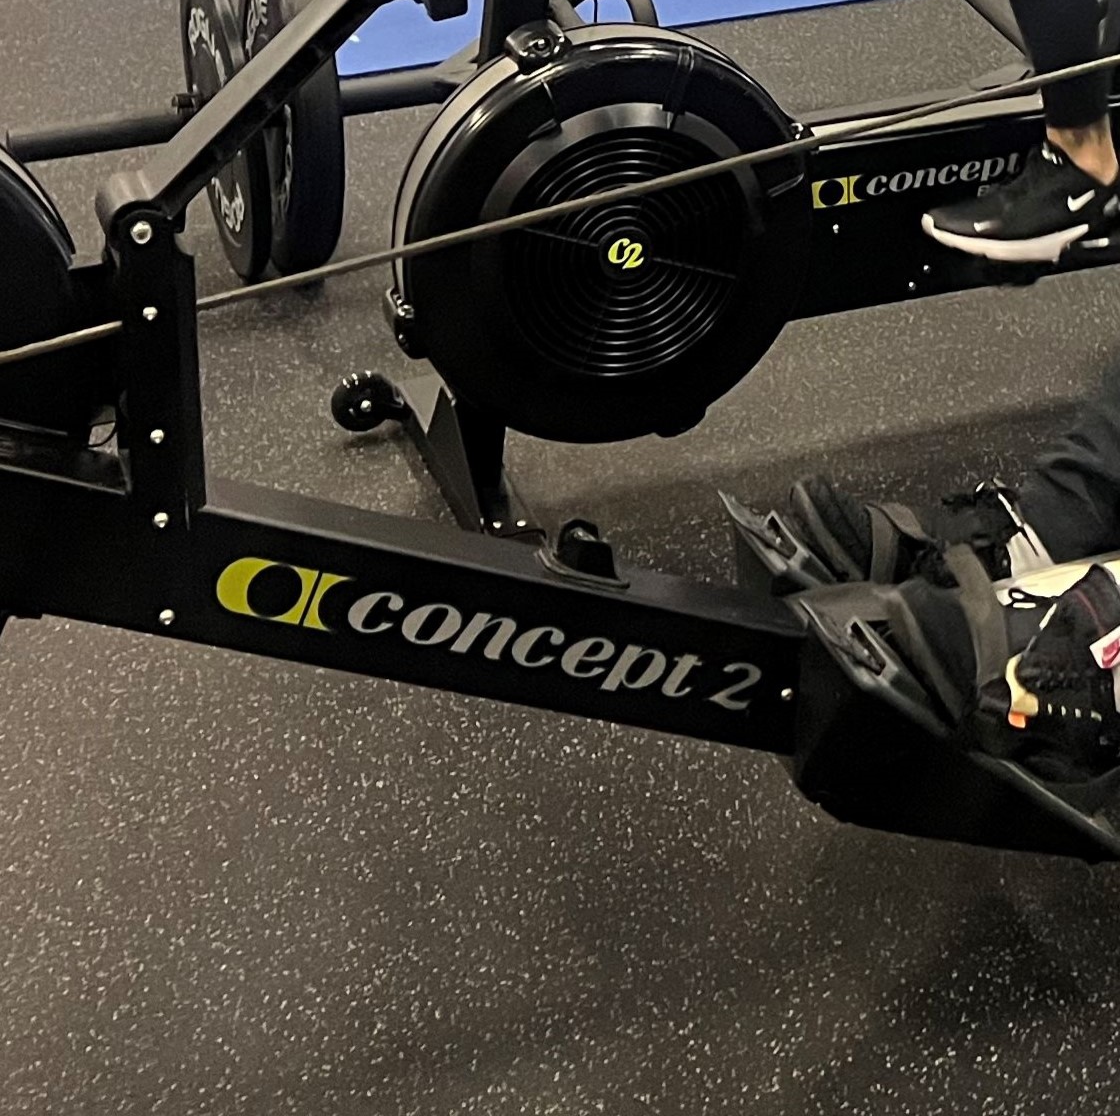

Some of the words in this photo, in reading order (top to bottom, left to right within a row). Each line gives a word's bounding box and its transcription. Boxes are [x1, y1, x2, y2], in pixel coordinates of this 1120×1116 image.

[866, 152, 1020, 196] concept
[346, 591, 702, 698] concept
[709, 661, 763, 711] 2
